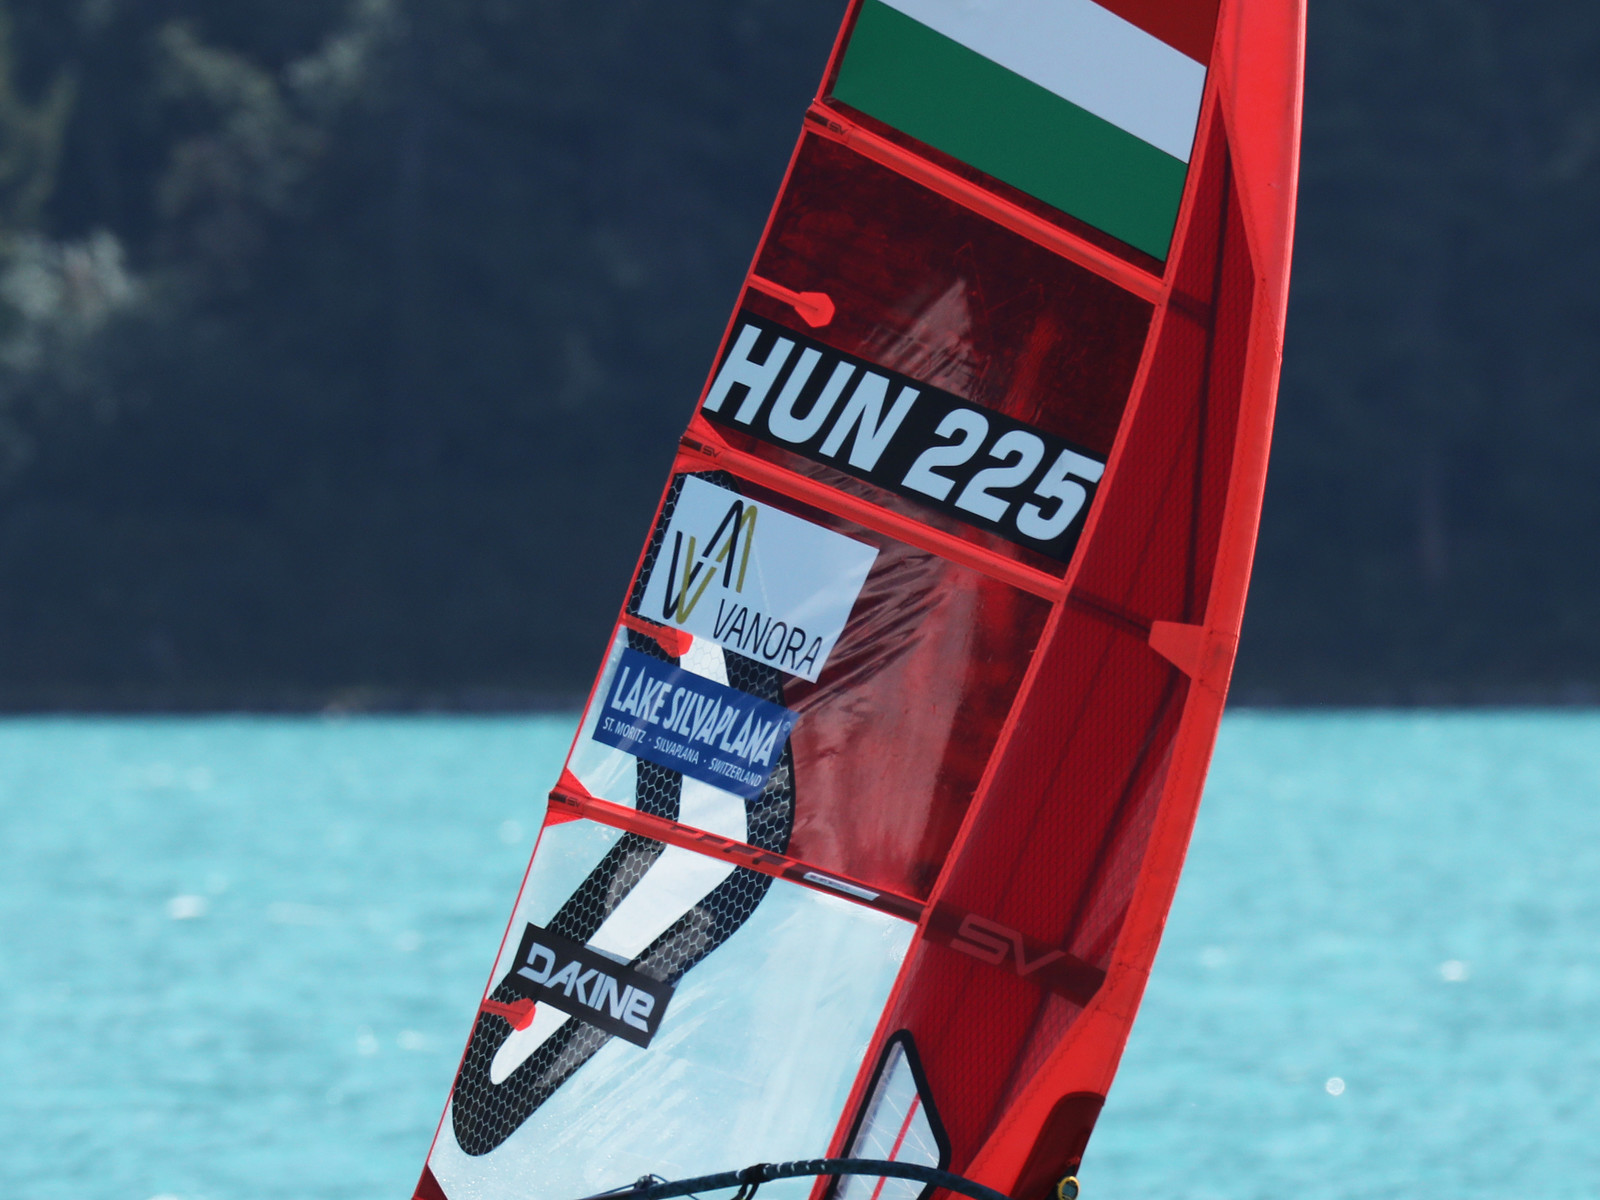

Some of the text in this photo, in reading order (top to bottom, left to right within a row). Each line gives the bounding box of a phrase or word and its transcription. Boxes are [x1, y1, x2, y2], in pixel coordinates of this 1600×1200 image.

[702, 323, 1105, 541] HUN 225
[713, 598, 823, 676] VANORA
[602, 716, 763, 788] ST. MORITZ SILVAPLANA SWITZERLAND
[610, 666, 784, 767] LAKE SILVAPLANA
[516, 941, 656, 1033] DAKINE
[951, 913, 1067, 977] SV
